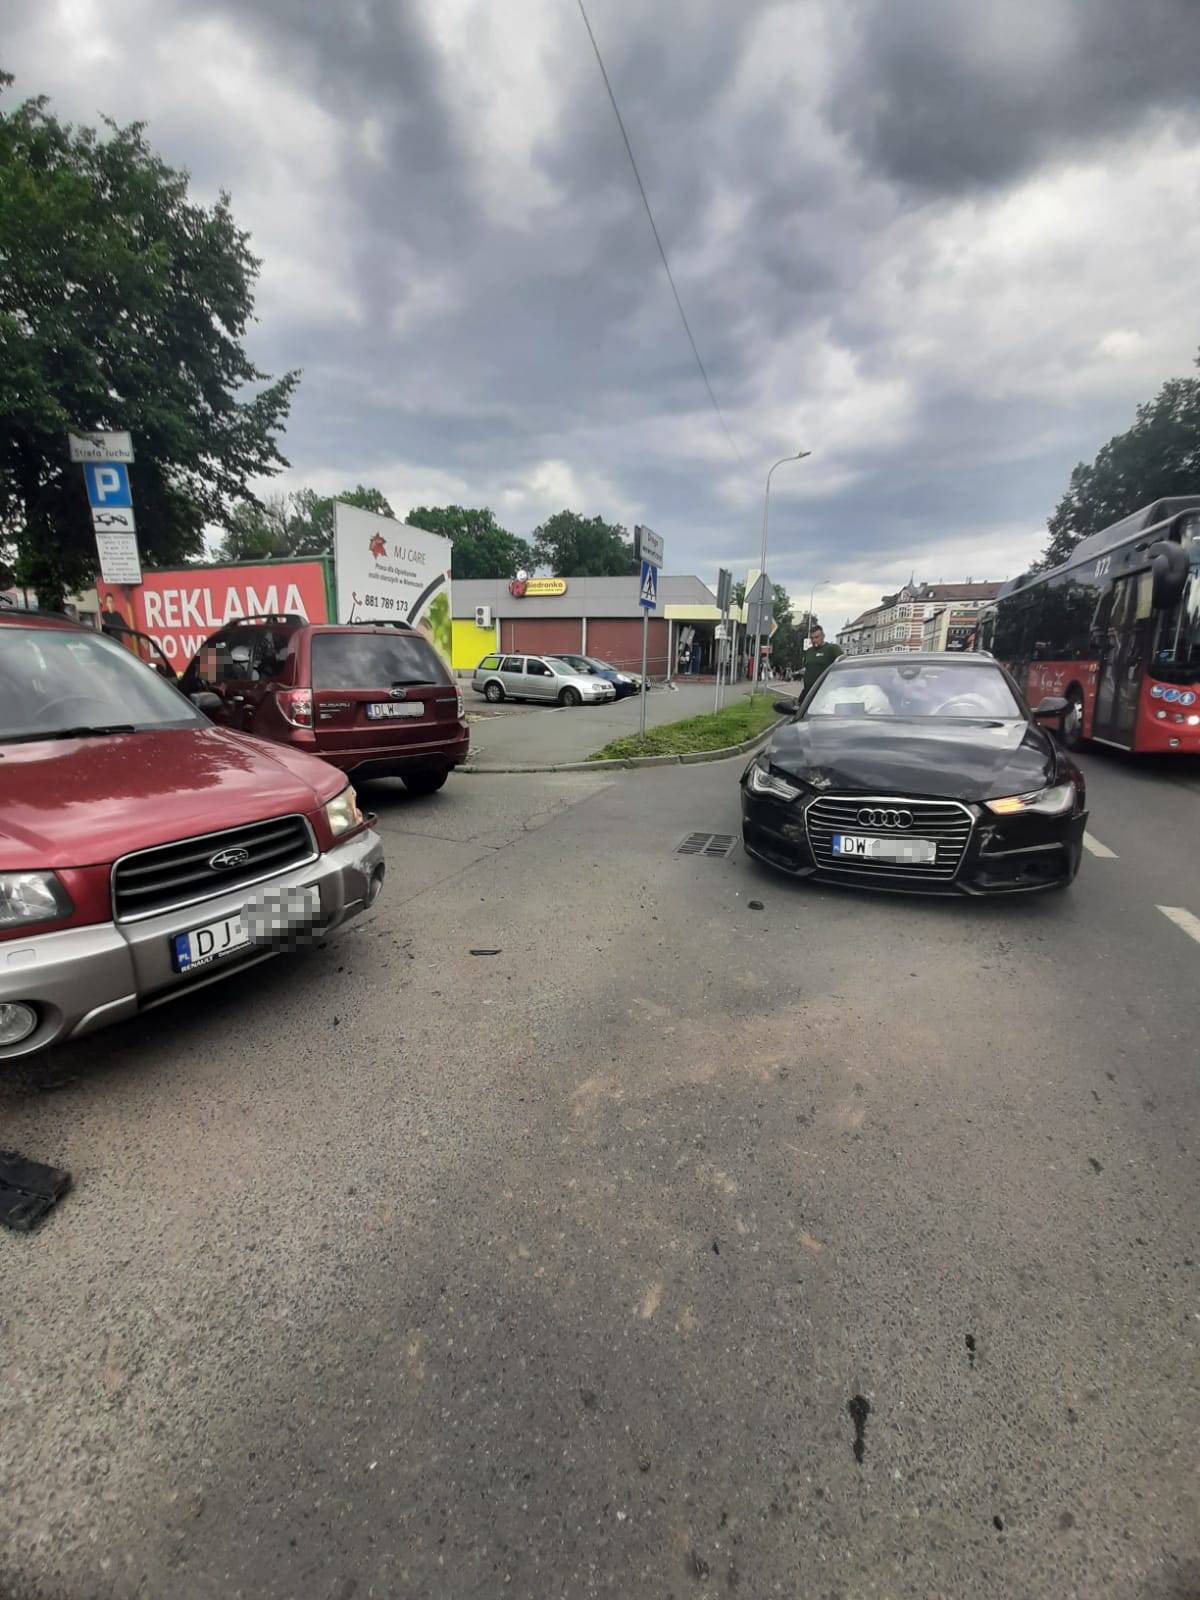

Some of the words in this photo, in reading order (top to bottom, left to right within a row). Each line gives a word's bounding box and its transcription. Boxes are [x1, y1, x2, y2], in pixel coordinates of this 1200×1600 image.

[94, 467, 121, 502] P
[393, 545, 406, 560] MJ
[143, 583, 309, 628] REKLAMA
[365, 594, 379, 607] 881
[381, 597, 394, 609] 789
[396, 599, 409, 612] 173
[148, 634, 177, 659] DO
[374, 703, 394, 716] DLW
[844, 837, 866, 854] DW
[196, 921, 232, 956] DJ
[180, 955, 214, 974] RENAULT
